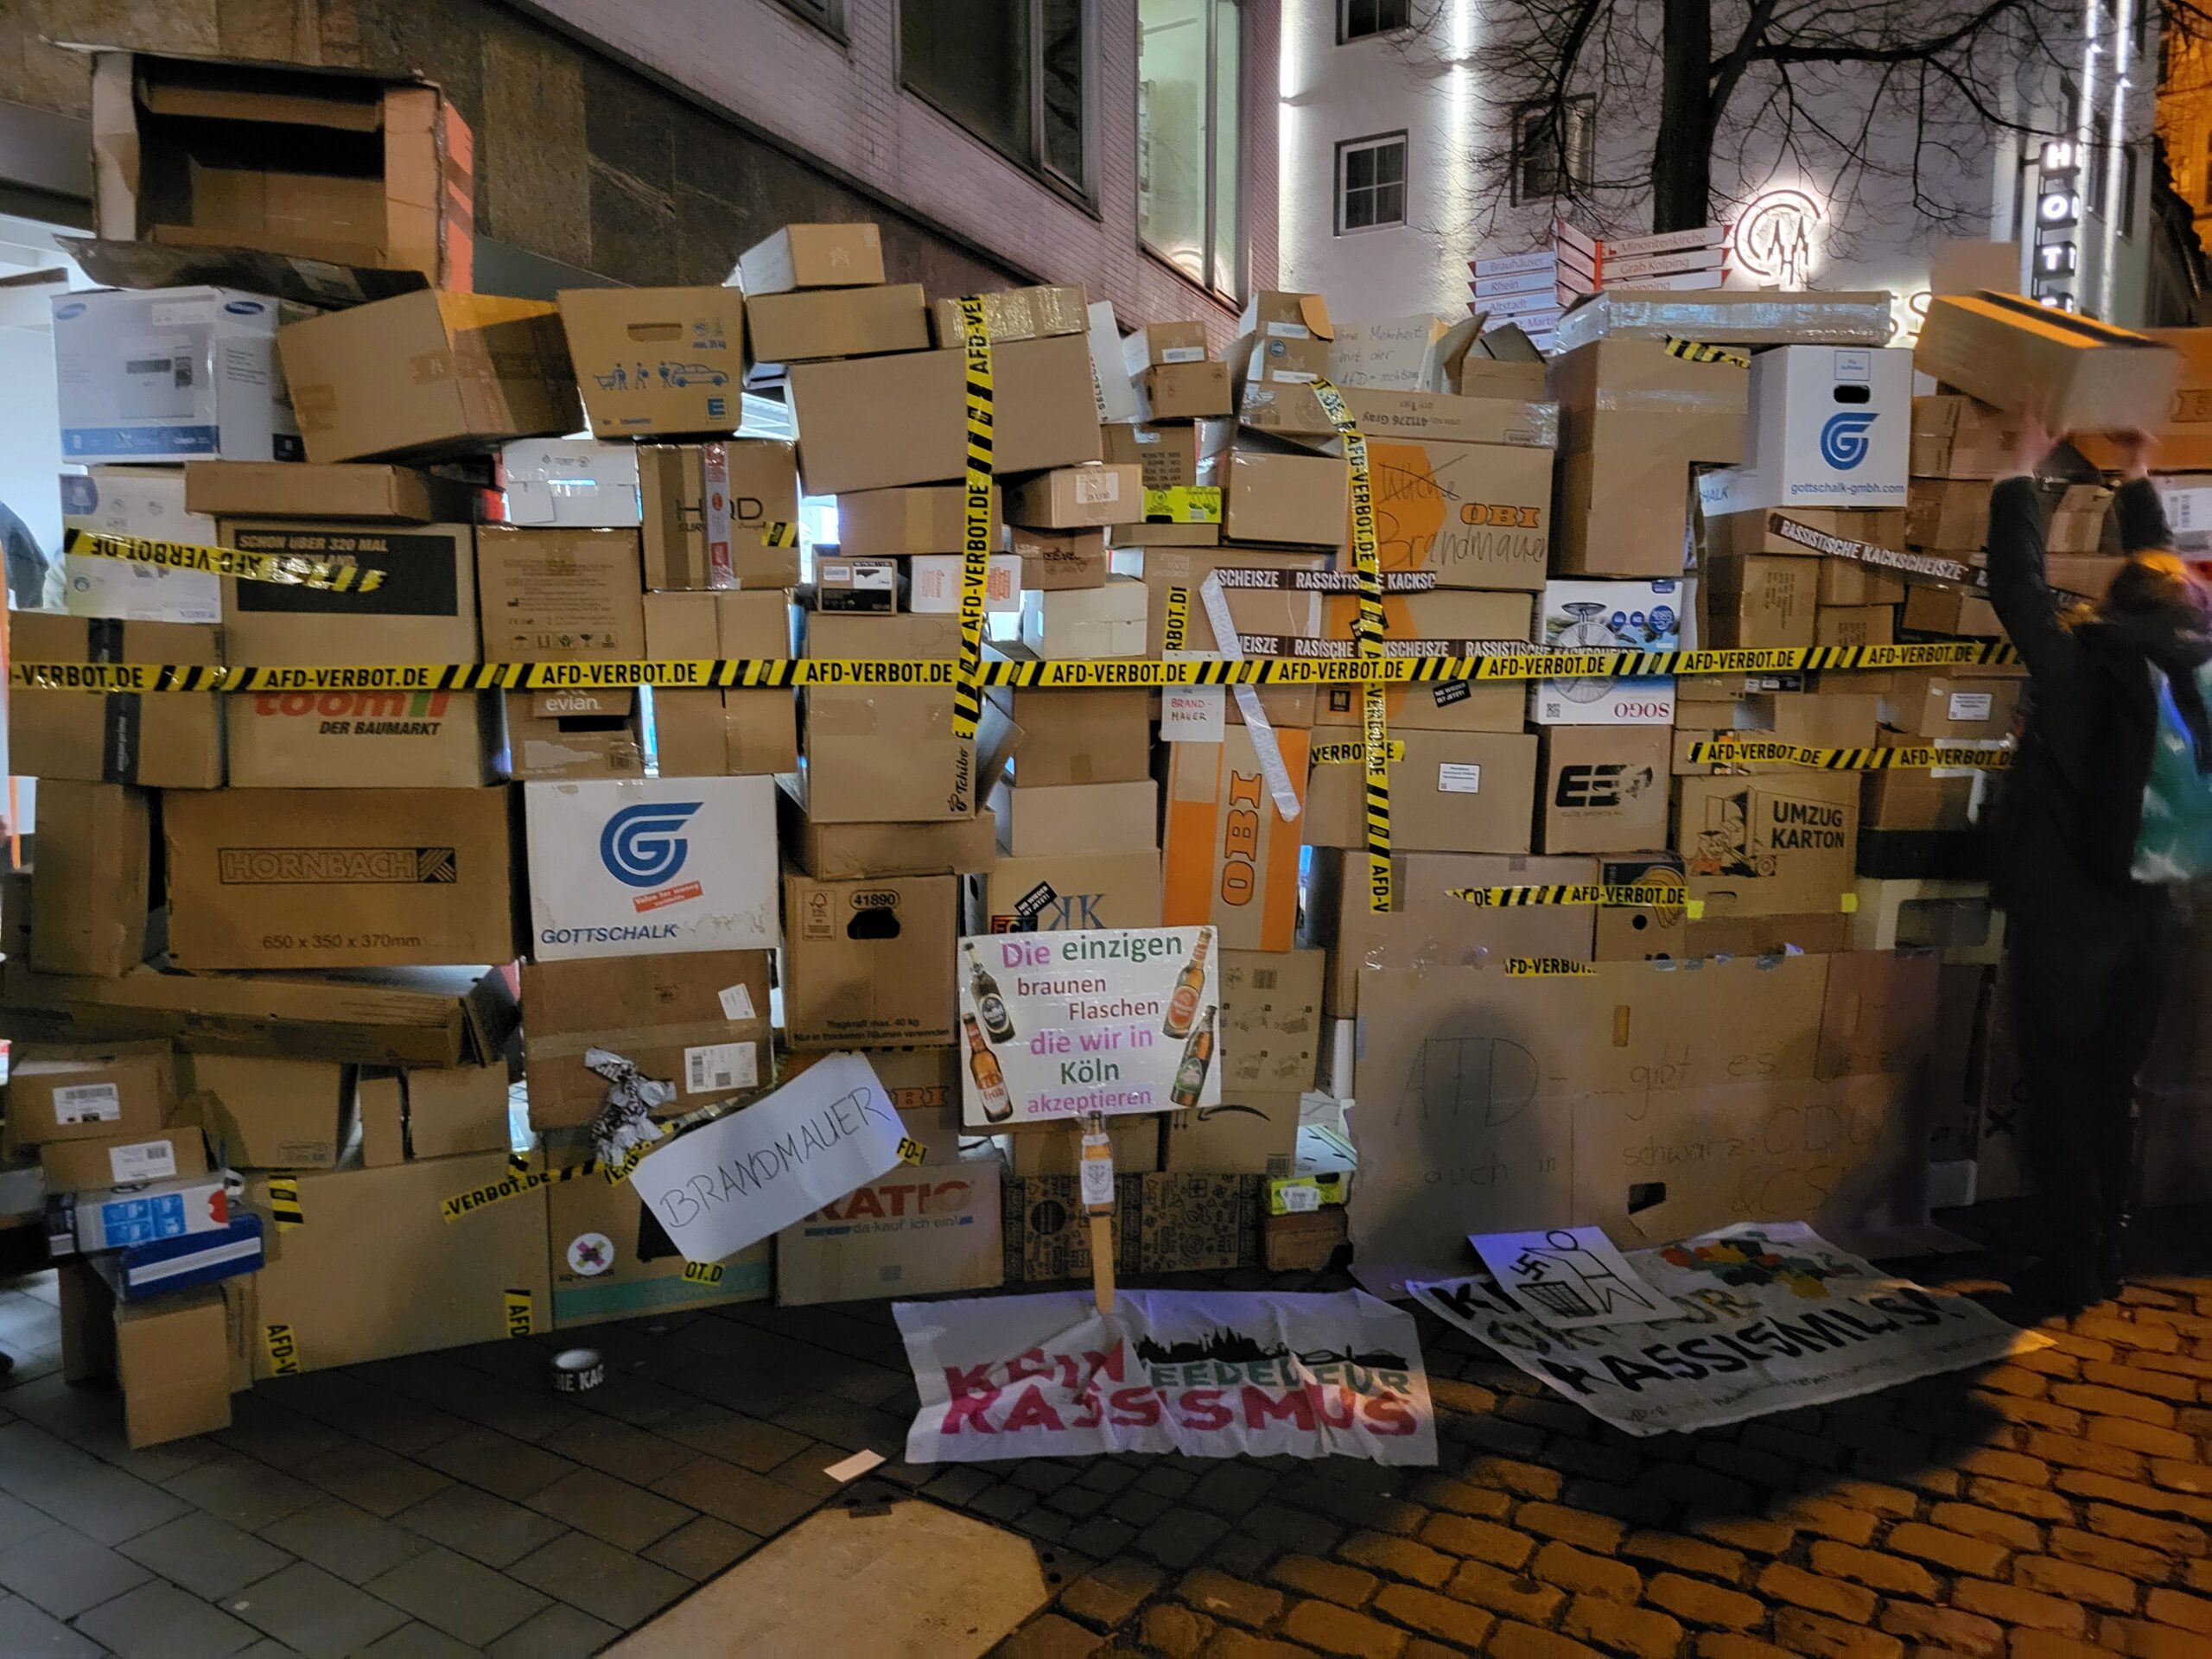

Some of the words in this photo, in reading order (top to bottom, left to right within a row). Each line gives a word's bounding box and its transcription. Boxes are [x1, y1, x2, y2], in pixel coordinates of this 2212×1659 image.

[2041, 143, 2072, 308] HOT
[1491, 280, 1521, 292] Rhein
[1489, 298, 1528, 312] Altstadt
[1363, 411, 1389, 425] Gray
[1790, 481, 1905, 496] gottschalk-gmbh.com
[1460, 503, 1541, 528] OBI
[961, 483, 988, 632] AFD-VERBOT.DE
[1781, 519, 1859, 559] RASSISTISCHE
[1861, 545, 1962, 582] KACKSCHEISZE
[1684, 650, 1796, 671] AFD-VERBOT.DE
[1868, 644, 1975, 664] AFD-VERBOT.DE
[541, 662, 698, 685] AFD-VERBOT.DE
[806, 662, 953, 683] AFD-VERBOT.DE
[1052, 663, 1188, 683] AFD-VERBOT.DE
[1278, 660, 1405, 681] AFD-VERBOT.DE
[1488, 654, 1606, 677] AFD-VERBOT.DE
[265, 667, 429, 688] AFD-VERBOT.DE
[1171, 710, 1207, 722] MAUER
[1614, 702, 1670, 719] SOGO
[319, 721, 351, 736] DER
[354, 721, 442, 736] BAUMARKT
[1707, 744, 1823, 765] AFD-VERBOT.DE
[954, 747, 969, 796] Tchibo
[1772, 800, 1844, 828] UMZUG
[1221, 771, 1263, 906] OBI
[1771, 828, 1845, 849] KARTON
[223, 850, 416, 880] HORNBACH
[854, 893, 896, 906] 41890
[1571, 886, 1685, 905] AFD-VERBOT.DE
[263, 933, 294, 949] 650
[312, 933, 343, 949] 350
[360, 933, 421, 949] 370mm
[540, 923, 678, 945] GOTTSCHALK
[1001, 940, 1052, 969] Die
[1062, 932, 1183, 963] einzigen
[1017, 976, 1107, 996] braunen
[1068, 999, 1160, 1021] Flaschen
[1030, 1033, 1071, 1056] die
[1079, 1029, 1122, 1052] wir
[1128, 1026, 1154, 1048] in
[1059, 1057, 1120, 1086] Köln
[1027, 1086, 1152, 1115] akzeptieren
[658, 1085, 892, 1230] BRANDMAUER
[874, 1218, 906, 1232] kauf
[909, 1218, 930, 1230] ich
[943, 1342, 1125, 1400] KEIN
